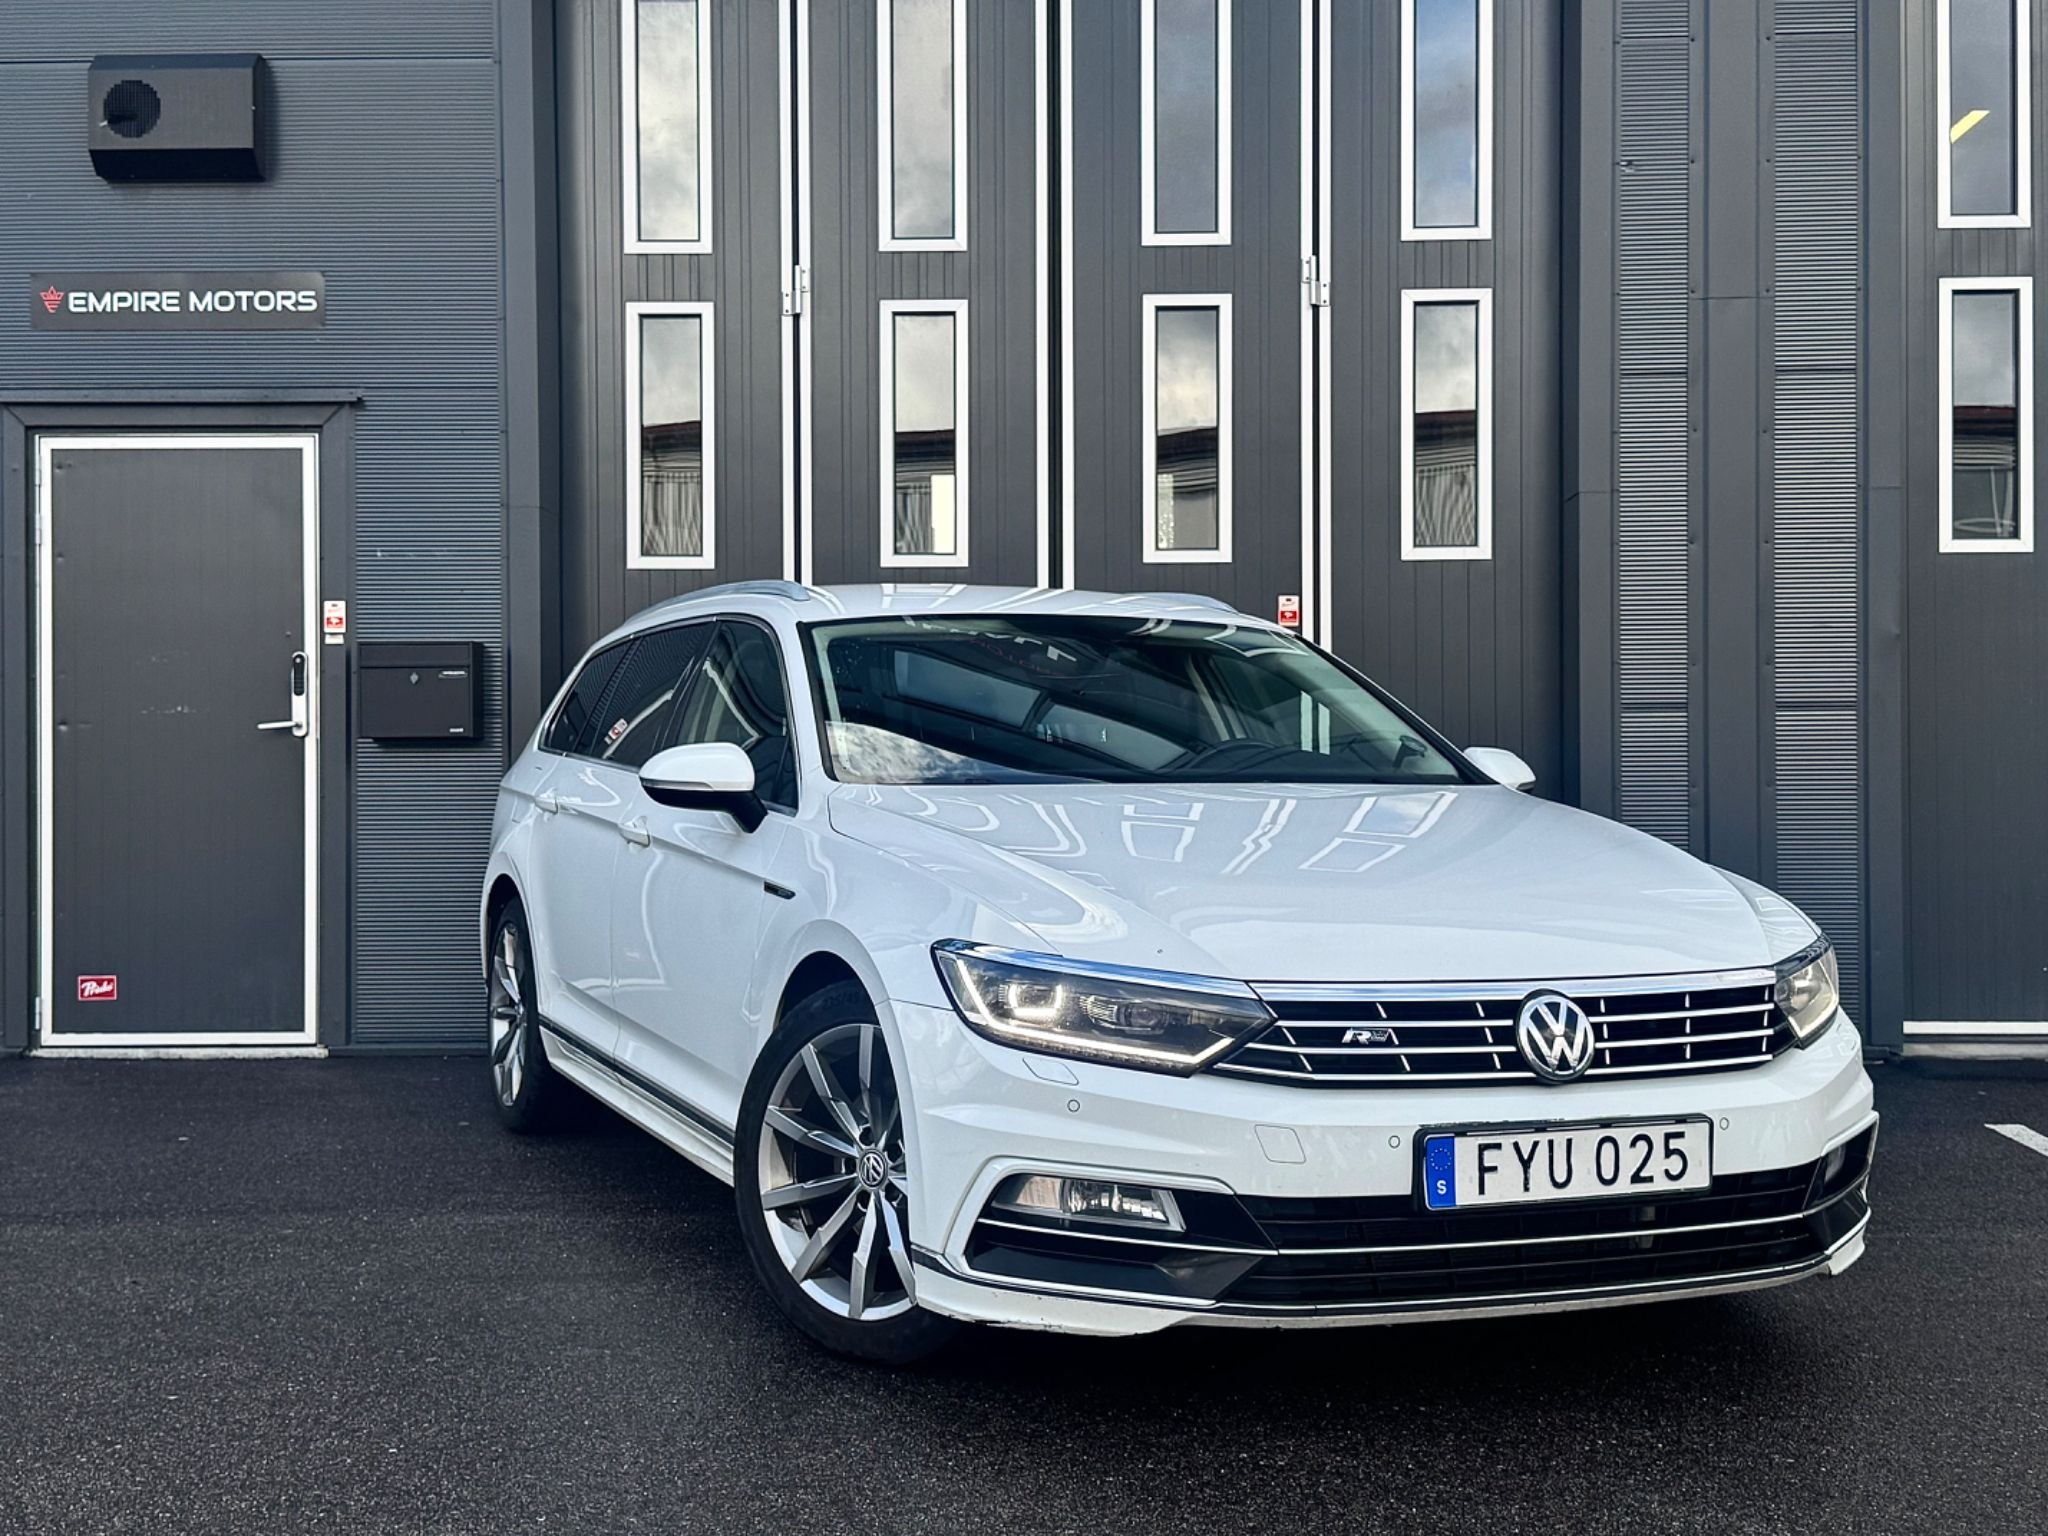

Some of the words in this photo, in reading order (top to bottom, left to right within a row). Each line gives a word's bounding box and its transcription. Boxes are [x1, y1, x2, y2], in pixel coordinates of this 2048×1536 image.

[68, 291, 181, 312] EMPIRE
[189, 290, 318, 312] MOTORS
[1477, 1137, 1574, 1196] FYU
[1595, 1131, 1689, 1187] 025
[1436, 1179, 1447, 1195] S
